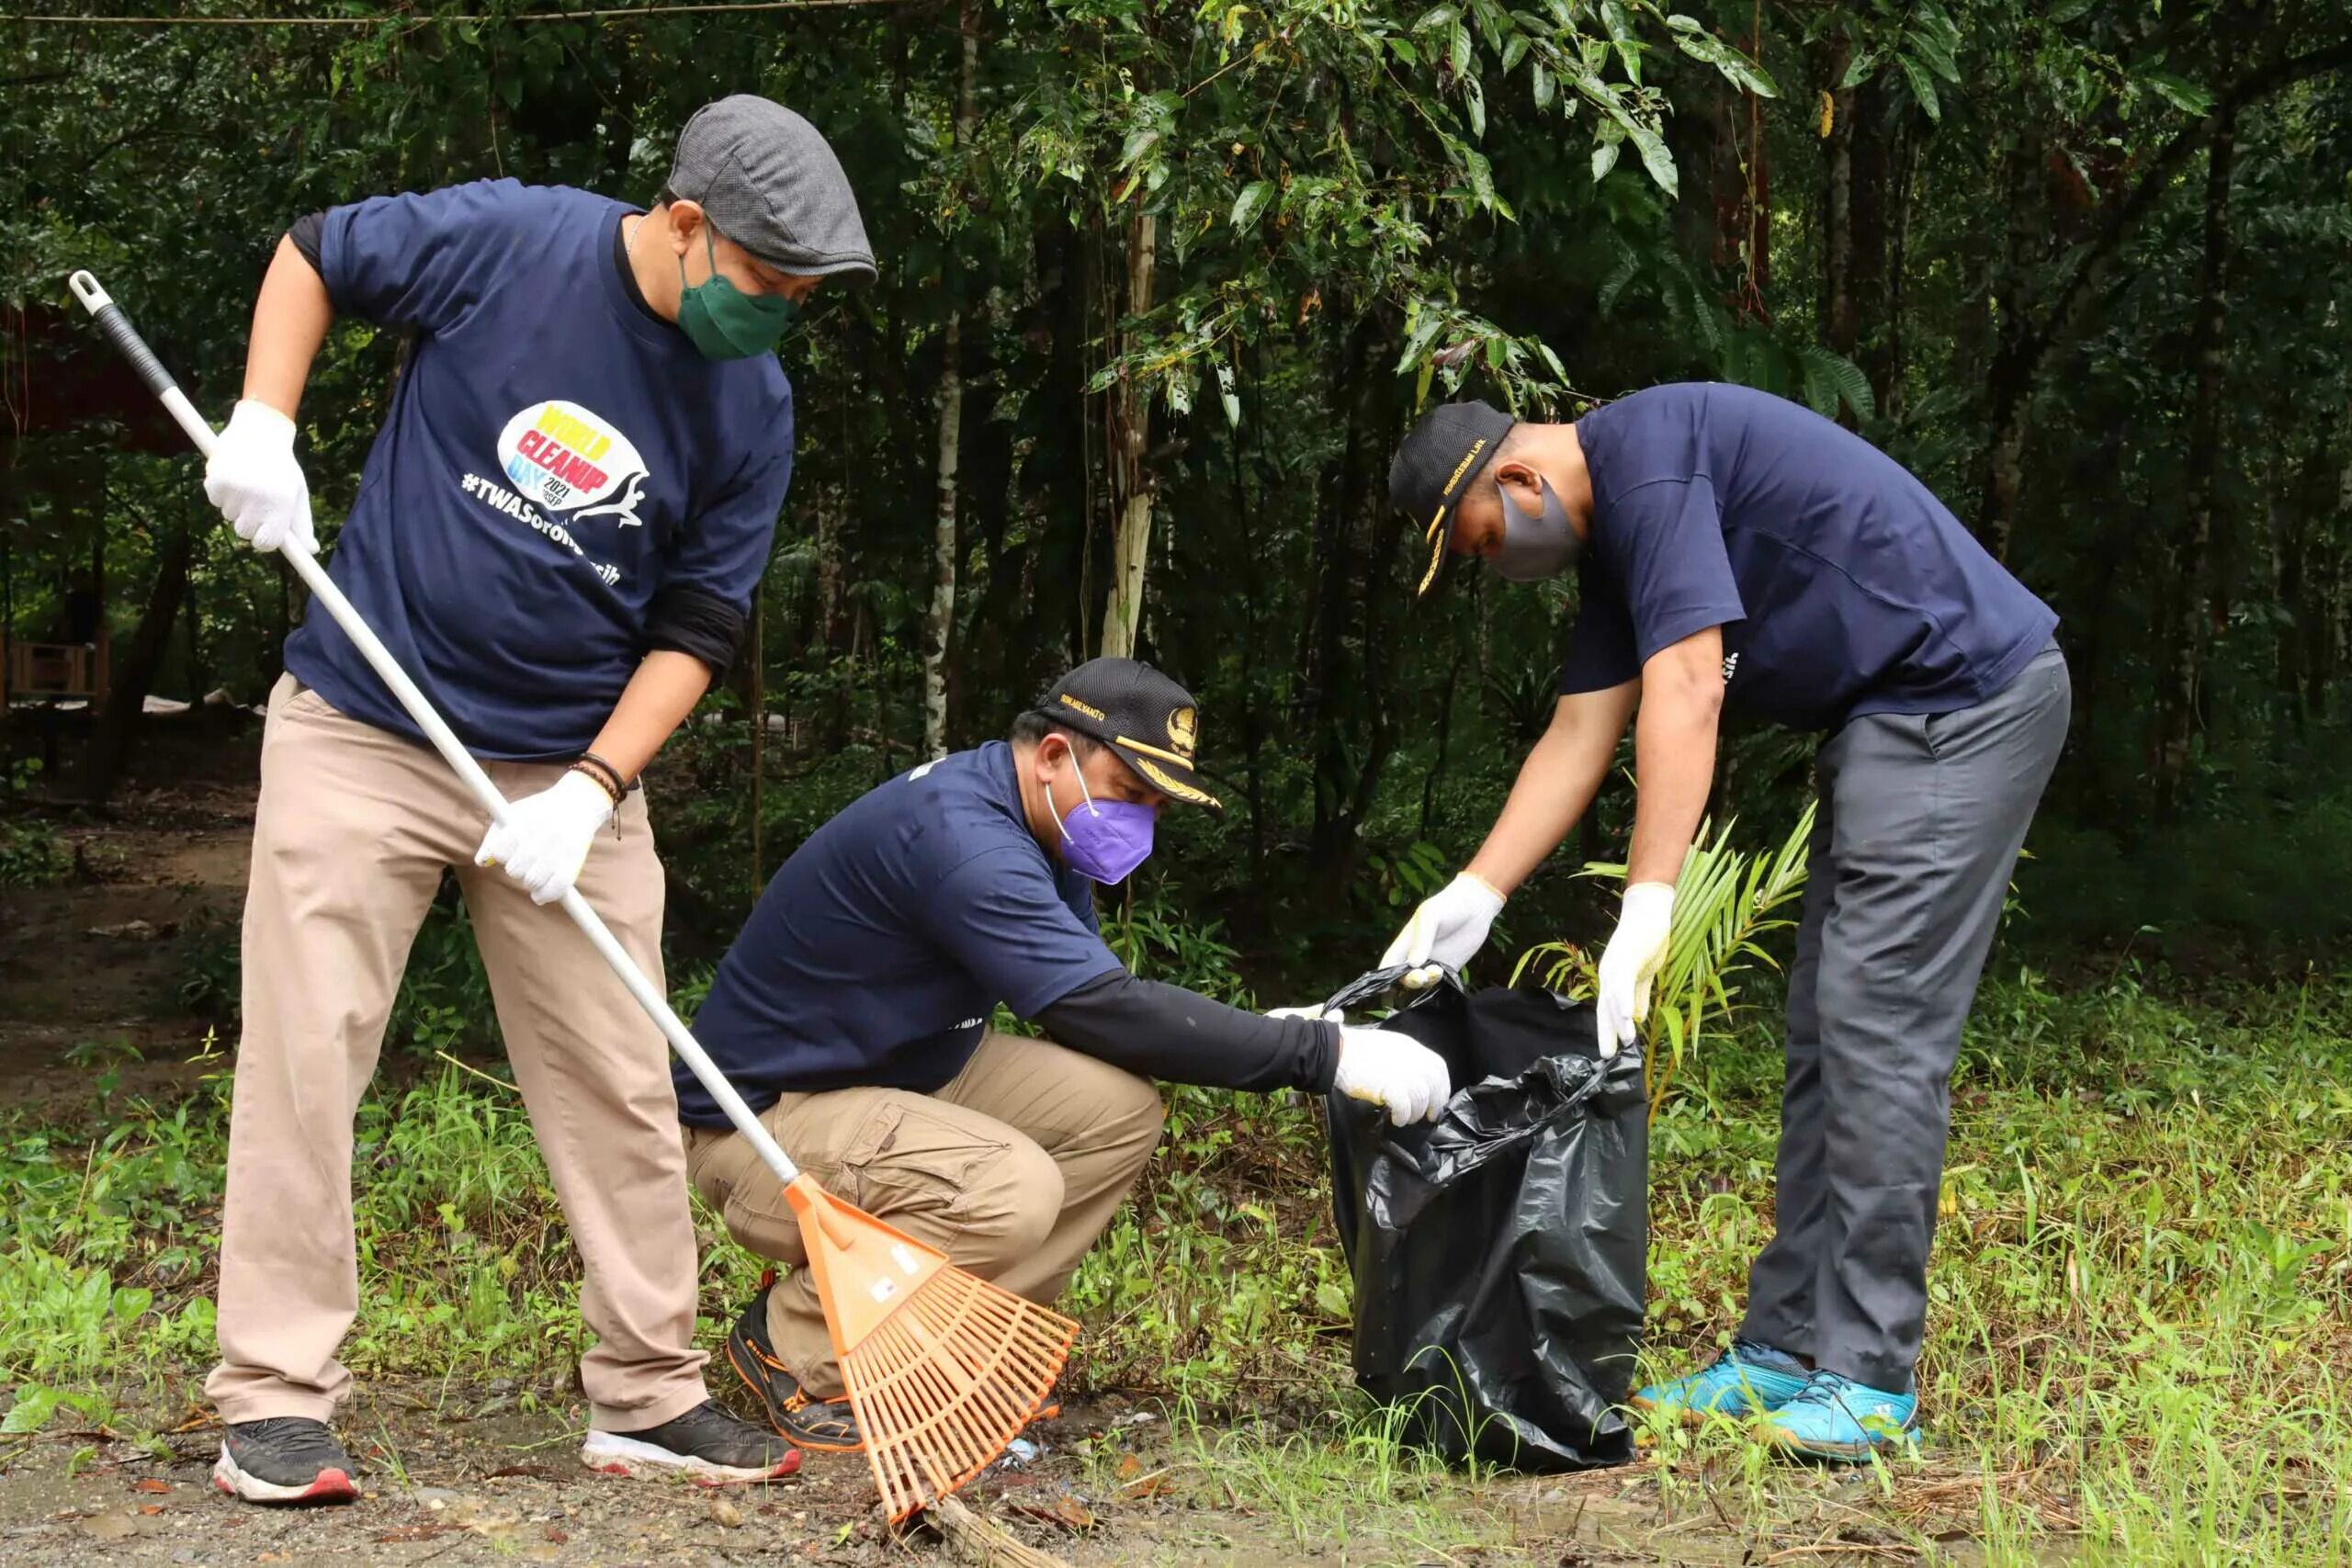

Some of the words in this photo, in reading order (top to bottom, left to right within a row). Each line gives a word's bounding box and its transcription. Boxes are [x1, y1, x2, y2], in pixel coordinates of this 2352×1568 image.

[536, 404, 612, 462] WORLD
[507, 454, 547, 490] DAY
[516, 429, 608, 494] CLEANUP
[544, 477, 570, 498] 2021
